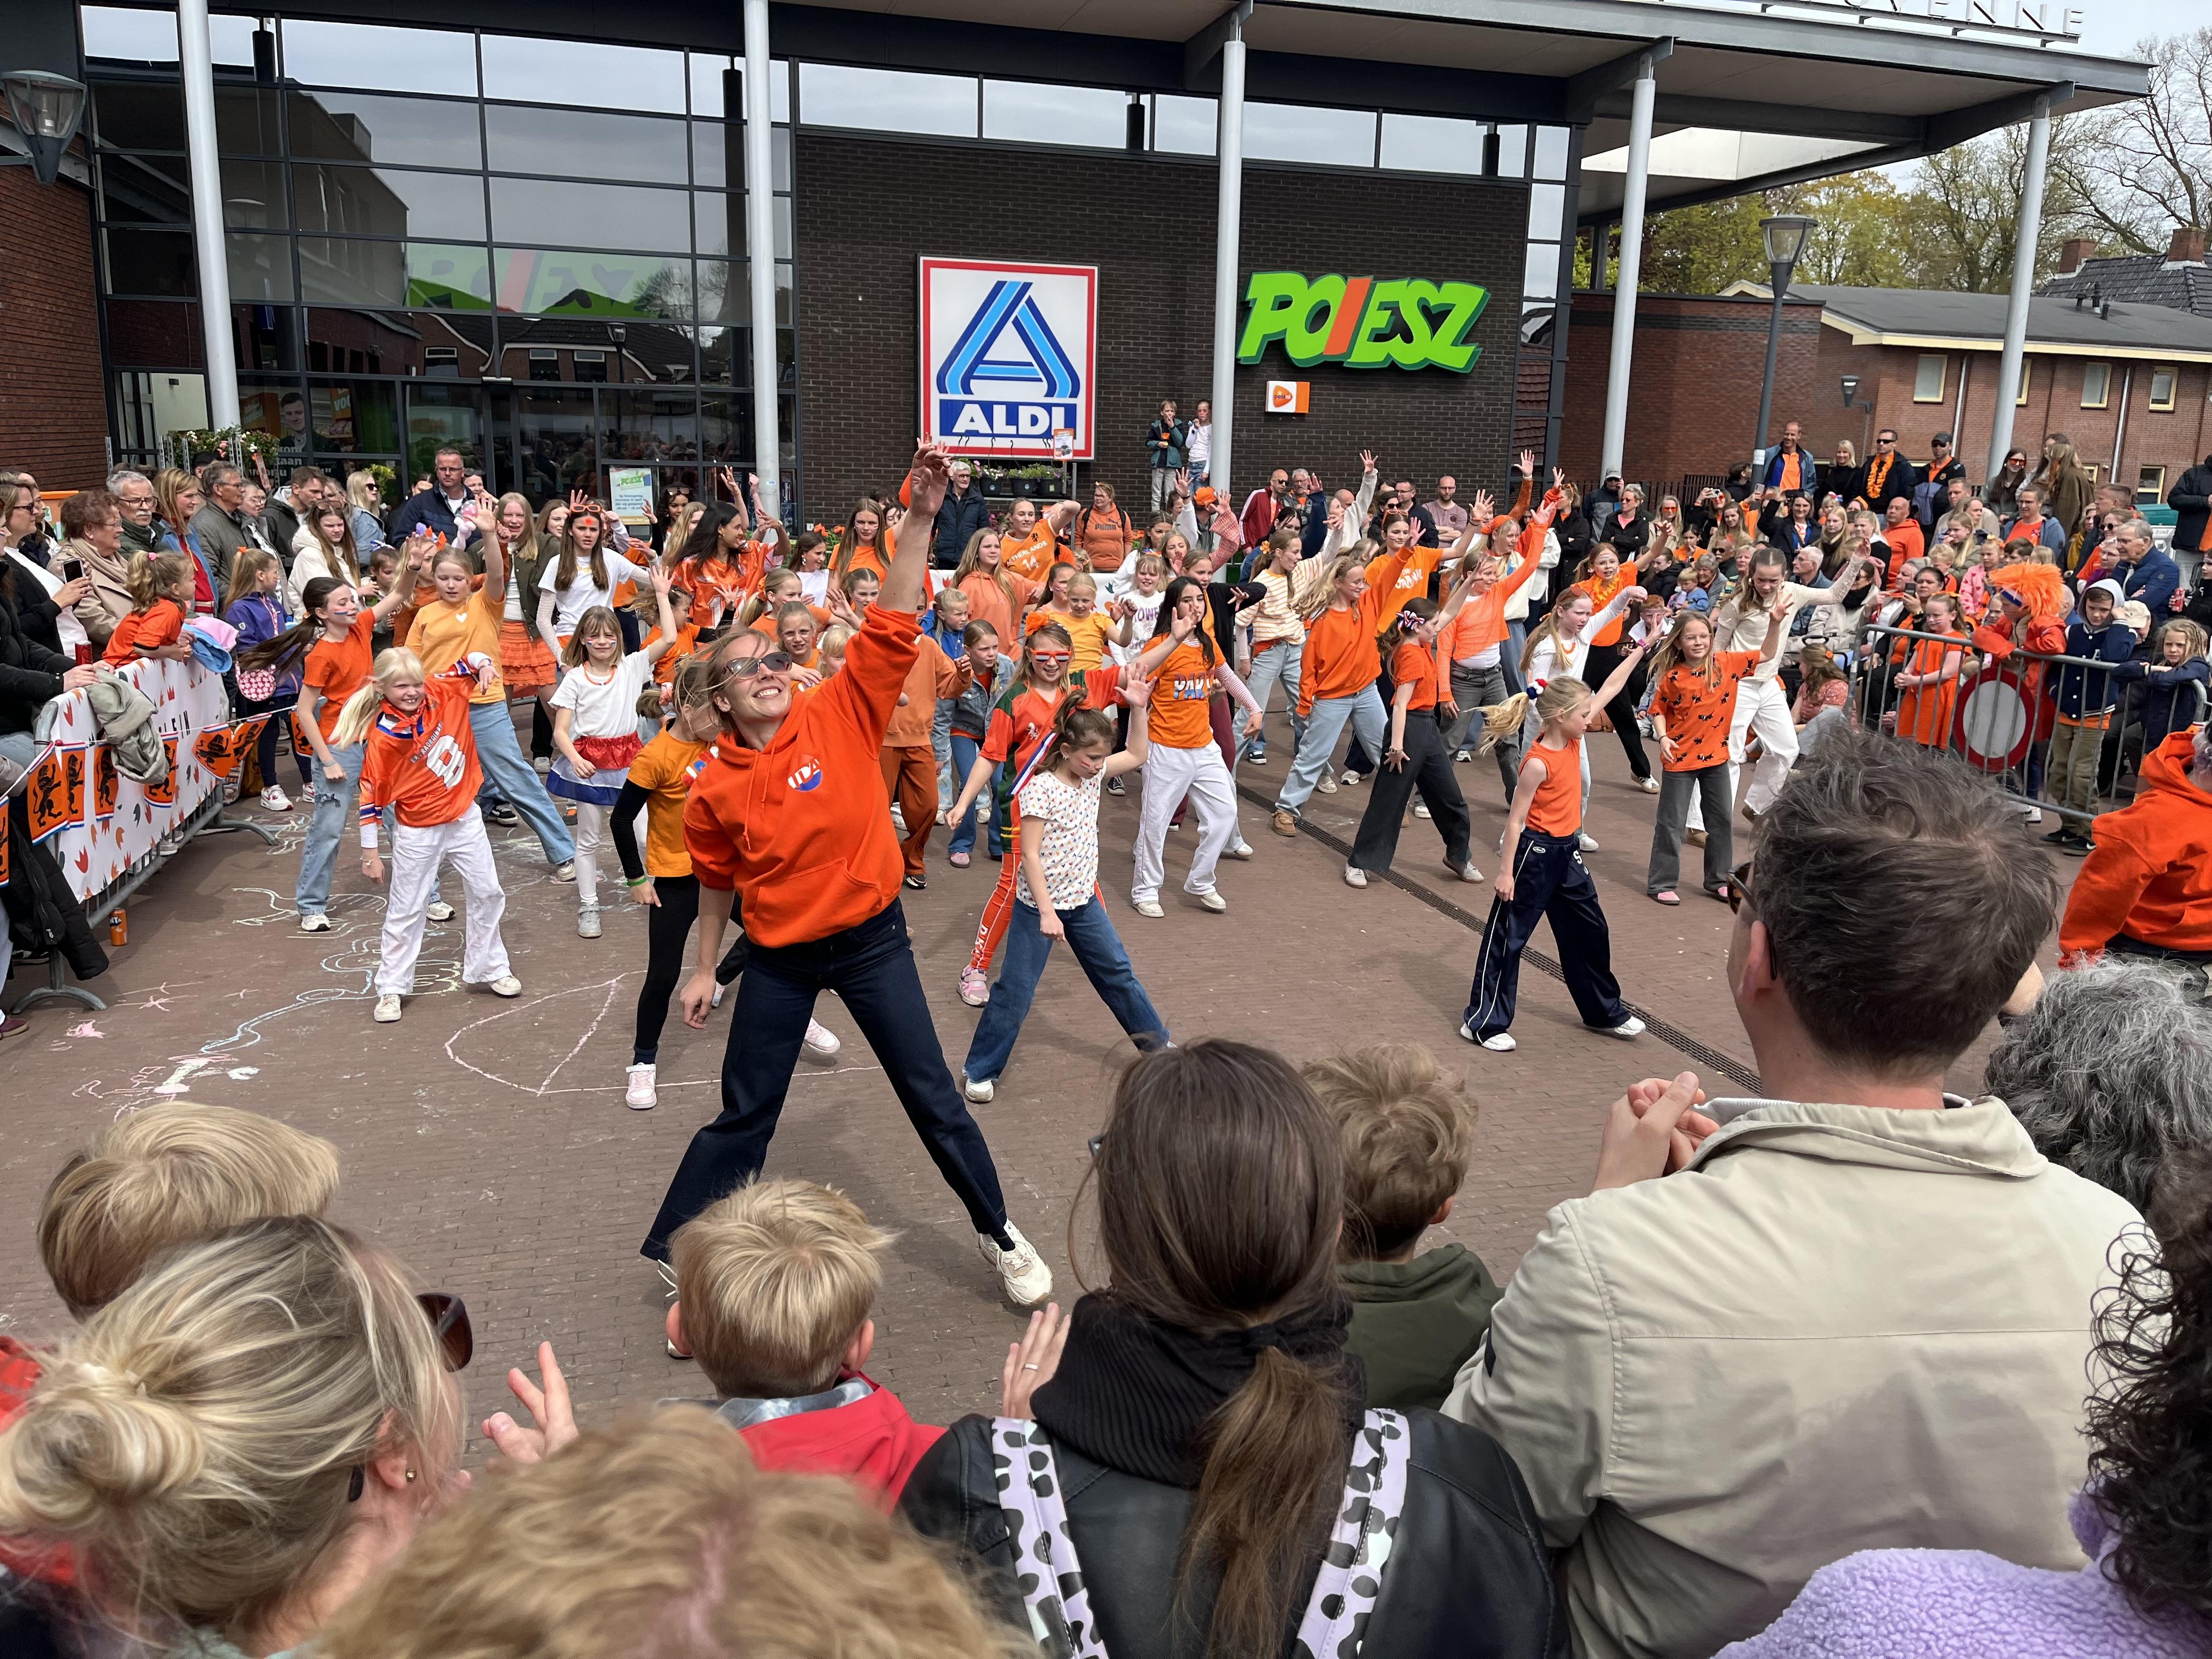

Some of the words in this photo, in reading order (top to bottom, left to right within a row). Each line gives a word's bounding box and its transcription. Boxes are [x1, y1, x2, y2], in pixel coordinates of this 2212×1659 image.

[1237, 271, 1491, 374] POIESZ
[952, 403, 1065, 436] ALDI
[1022, 555, 1040, 571] 14
